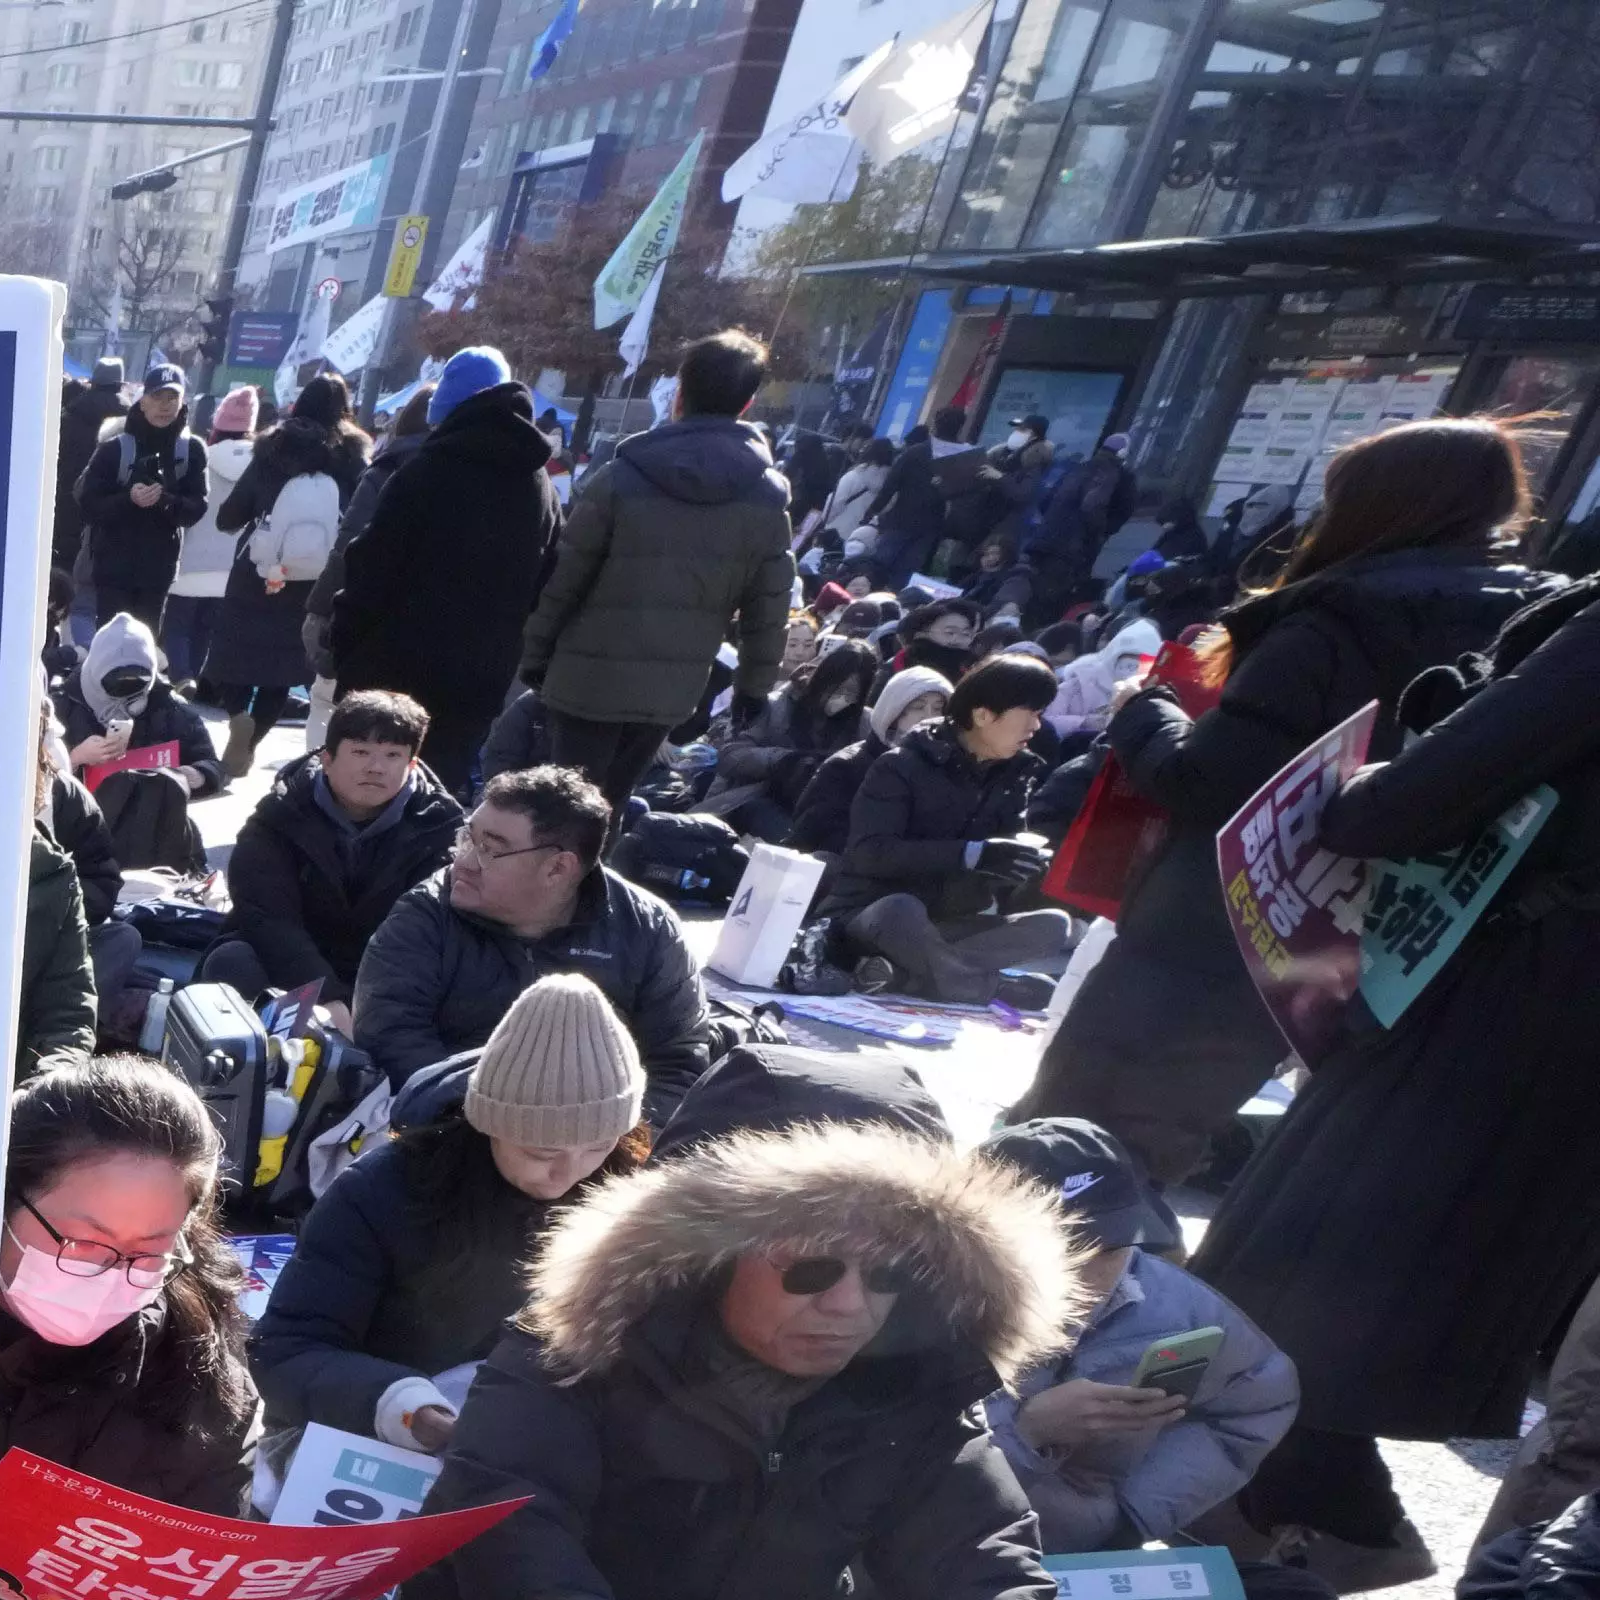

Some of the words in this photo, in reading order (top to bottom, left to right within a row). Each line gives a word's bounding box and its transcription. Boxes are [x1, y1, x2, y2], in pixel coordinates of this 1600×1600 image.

[1240, 798, 1308, 938] 윤석열
[20, 1459, 102, 1501] 나눔문화
[106, 1496, 258, 1543] www.nanum.com
[56, 1516, 401, 1600] 윤석열을
